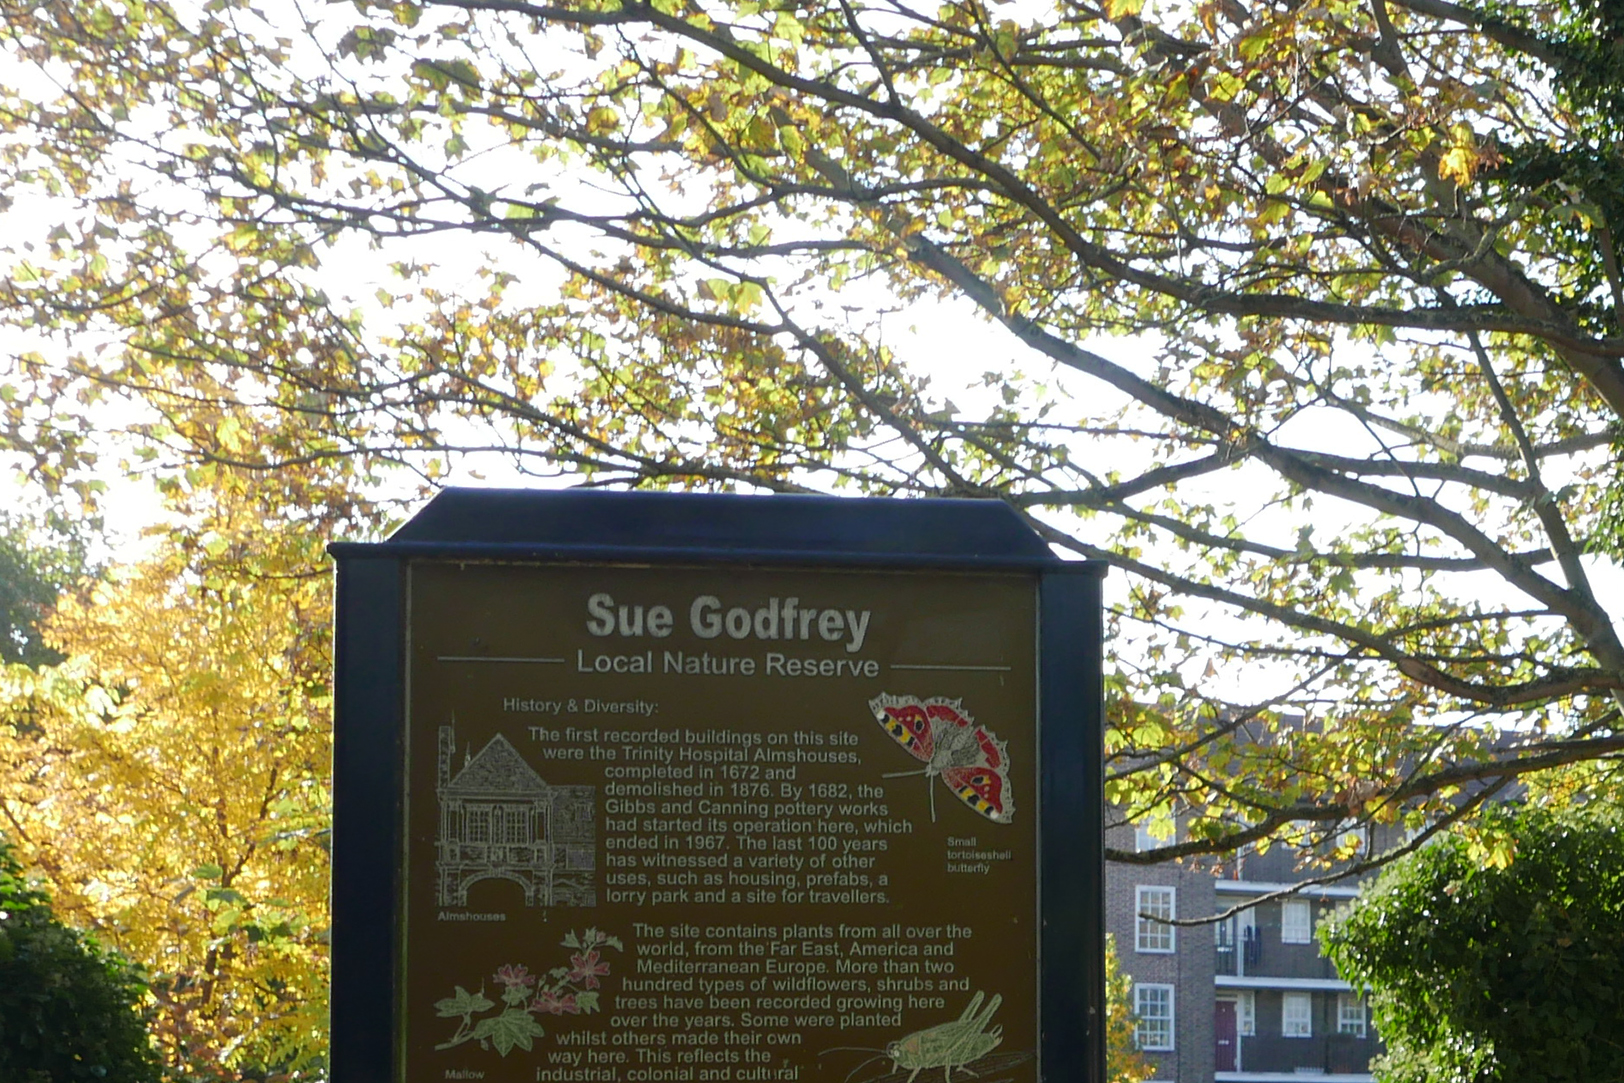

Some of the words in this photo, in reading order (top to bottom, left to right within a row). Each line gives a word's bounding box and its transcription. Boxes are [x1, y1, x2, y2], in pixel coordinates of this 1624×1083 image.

[586, 593, 673, 637] Sue
[690, 595, 871, 653] Godfrey
[578, 649, 652, 673] Local
[664, 651, 755, 675] Nature
[766, 652, 879, 677] Reserve
[504, 697, 562, 715] History
[567, 698, 578, 712] &
[584, 699, 658, 717] Diversity:
[528, 726, 560, 742] The
[565, 727, 598, 742] first
[604, 728, 679, 743] recorded
[685, 729, 762, 749] buildings
[767, 733, 788, 745] on
[793, 730, 824, 745] this
[829, 730, 858, 746] site
[543, 748, 584, 760] were
[590, 745, 616, 760] the
[622, 745, 673, 764] Trinity
[680, 745, 751, 765] Hospital
[753, 747, 861, 765] Almshouses,
[605, 763, 693, 782] completed
[699, 764, 713, 779] in
[720, 765, 760, 780] 1672
[765, 765, 796, 780] and
[605, 798, 655, 814] Gibbs
[661, 799, 692, 814] and
[698, 799, 768, 818] Canning
[774, 801, 834, 819] pottery
[838, 801, 888, 816] works
[606, 816, 637, 831] had
[643, 817, 702, 832] started
[708, 817, 727, 832] its
[733, 818, 812, 837] operation
[818, 818, 858, 835] here,
[864, 819, 912, 833] which
[606, 834, 658, 849] ended
[664, 835, 679, 849] in
[686, 835, 730, 850] 1967.
[736, 833, 767, 850] The
[773, 835, 802, 851] last
[808, 836, 837, 851] 100
[843, 839, 888, 856] years
[947, 836, 976, 846] Small
[947, 849, 1011, 860] tortoiseshell
[947, 862, 990, 875] butterfly
[607, 888, 646, 906] lorry
[652, 888, 689, 906] park
[694, 888, 725, 903] and
[731, 891, 741, 903] a
[746, 888, 776, 903] site
[781, 888, 805, 903] for
[809, 889, 889, 904] travellers.
[437, 911, 506, 921] Almshouses
[632, 923, 664, 938] The
[670, 923, 700, 938] site
[705, 923, 777, 938] contains
[783, 923, 833, 942] plants
[839, 923, 876, 938] from
[882, 924, 900, 938] all
[906, 927, 942, 938] over
[946, 924, 972, 938] the
[637, 940, 689, 958] world,
[694, 941, 733, 955] from
[738, 941, 764, 956] the
[770, 941, 797, 956] Far
[802, 941, 843, 958] East,
[849, 941, 918, 956] America
[923, 941, 954, 956] and
[637, 959, 759, 974] Mediterranean
[766, 959, 829, 977] Europe.
[836, 959, 878, 974] More
[883, 959, 919, 974] than
[924, 959, 954, 974] two
[615, 995, 657, 1009] trees
[664, 994, 704, 1009] have
[709, 994, 750, 1009] been
[756, 994, 831, 1009] recorded
[836, 994, 903, 1014] growing
[908, 994, 945, 1009] here
[556, 1030, 607, 1045] whilst
[612, 1030, 666, 1045] others
[672, 1030, 719, 1045] made
[724, 1030, 762, 1045] their
[767, 1033, 801, 1045] own
[548, 1052, 582, 1067] way
[588, 1048, 629, 1063] here.
[635, 1048, 671, 1063] This
[678, 1048, 740, 1063] reflects
[745, 1048, 771, 1063] the
[445, 1069, 485, 1080] Mallow
